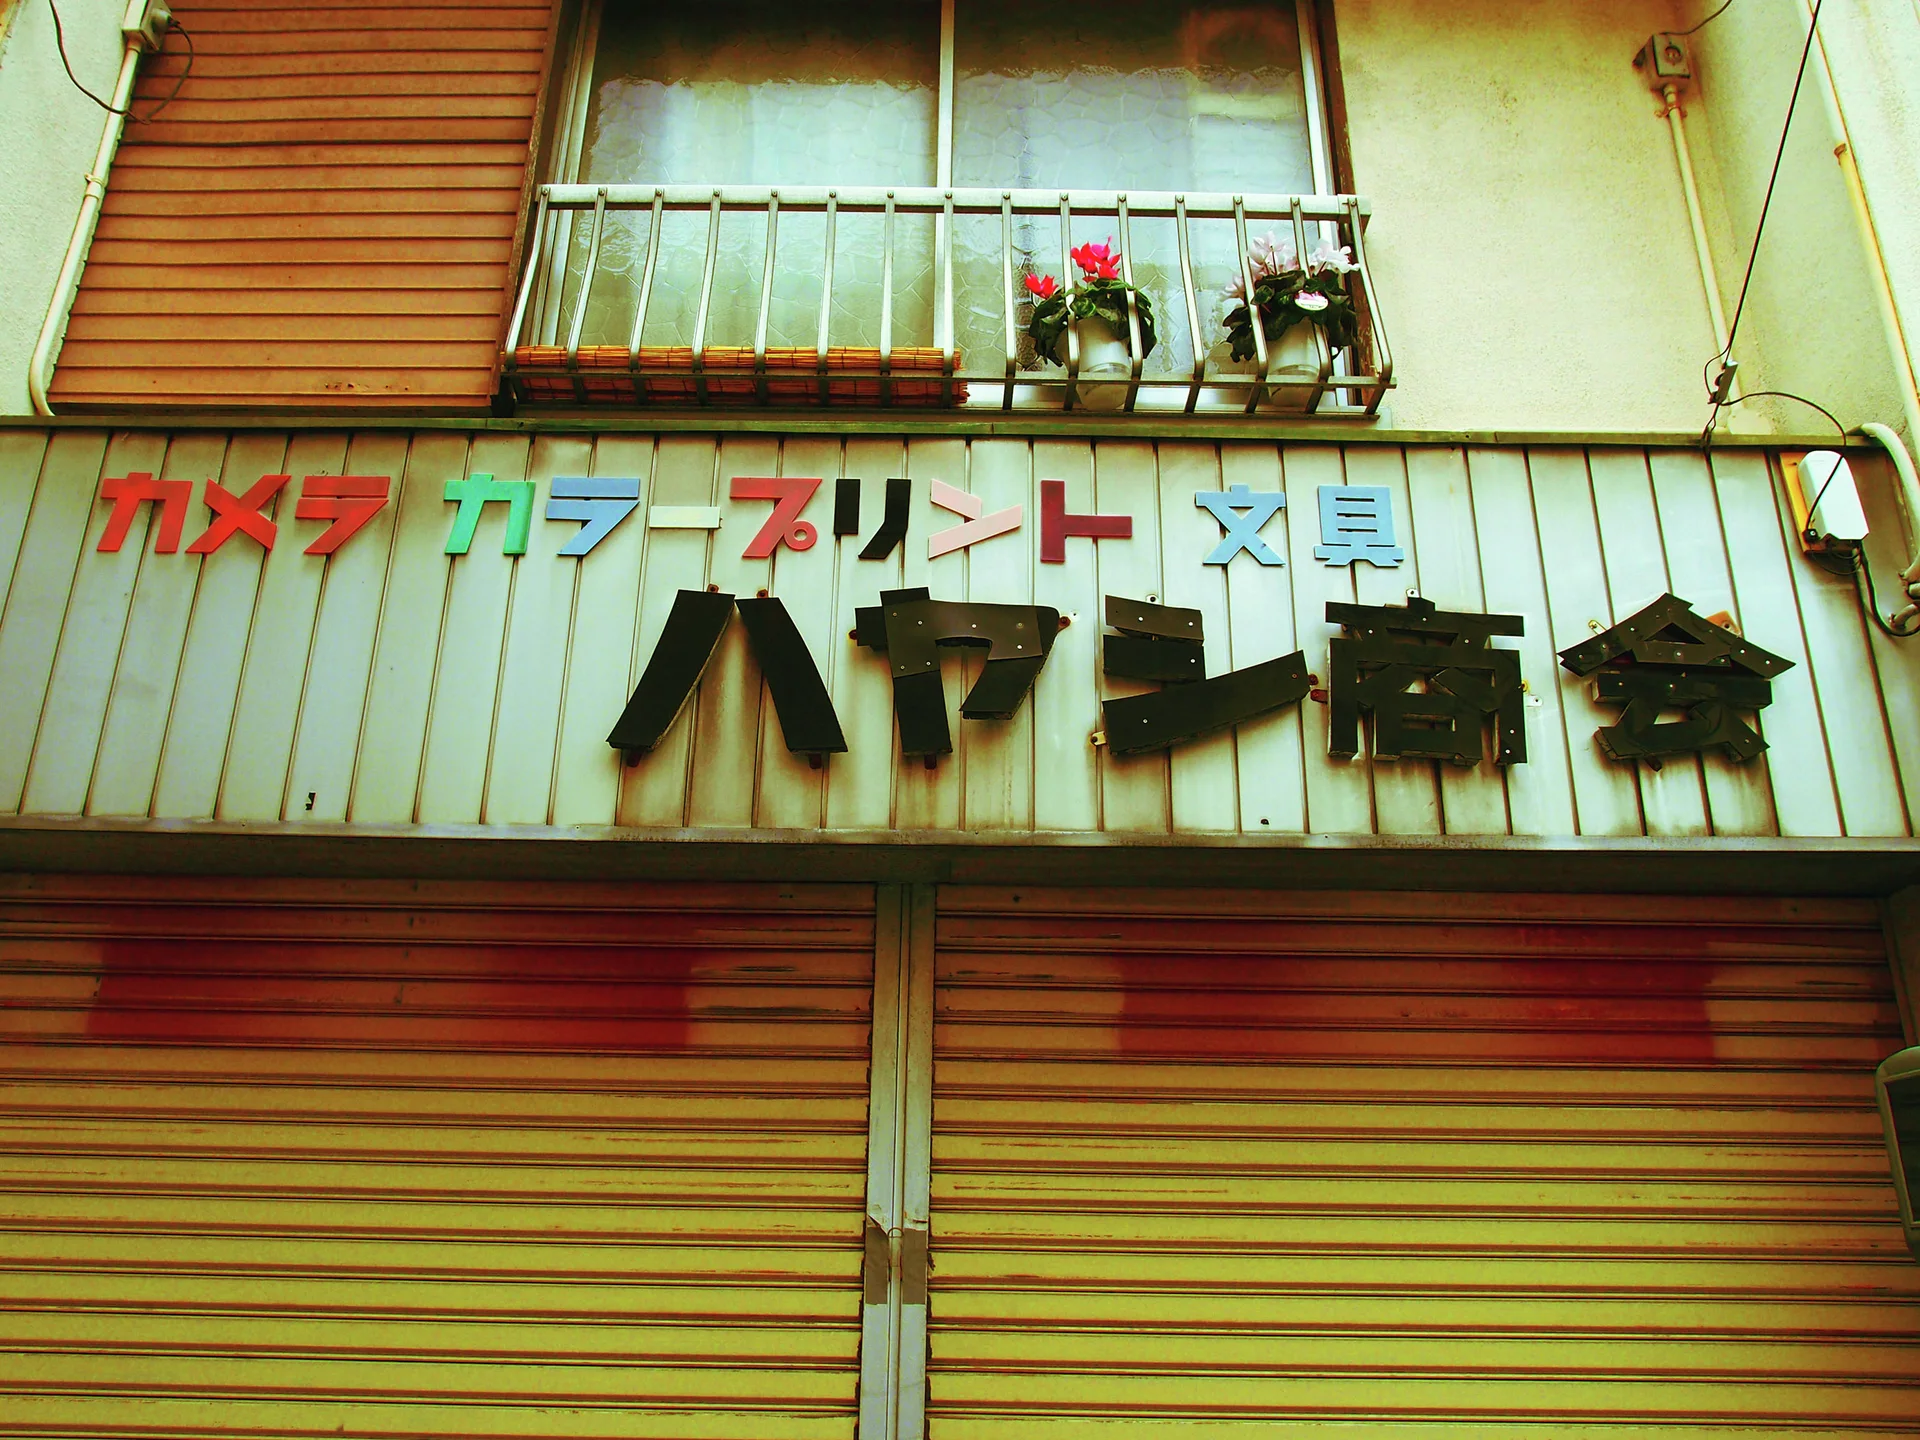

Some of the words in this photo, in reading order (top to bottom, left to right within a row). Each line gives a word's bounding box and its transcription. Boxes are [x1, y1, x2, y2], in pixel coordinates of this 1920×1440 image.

[97, 472, 391, 555] カメラ
[443, 473, 1133, 562] カラープリント
[1194, 484, 1404, 567] 文具
